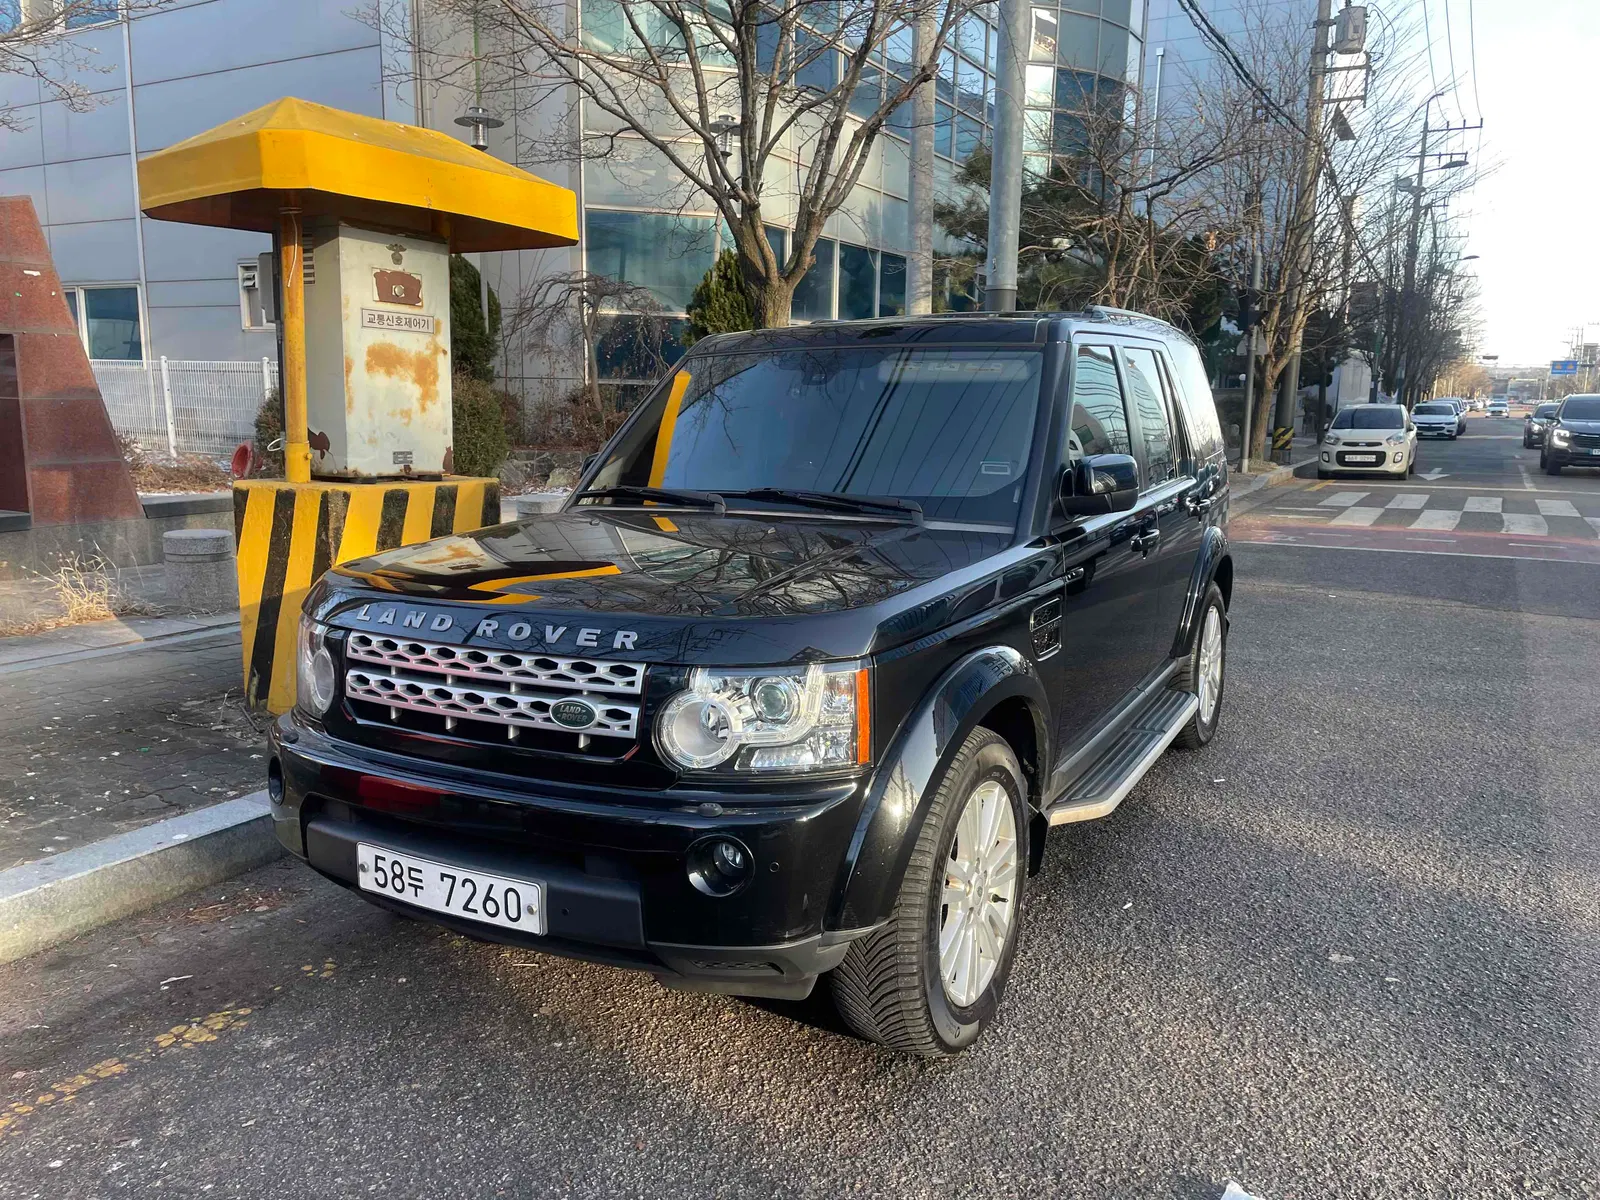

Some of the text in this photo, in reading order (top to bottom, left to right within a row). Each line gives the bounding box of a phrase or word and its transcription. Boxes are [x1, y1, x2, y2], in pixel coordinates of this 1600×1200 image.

[367, 313, 430, 330] 교통신호제어기
[356, 604, 639, 650] LAND ROVER
[374, 854, 522, 923] 58두 7260
